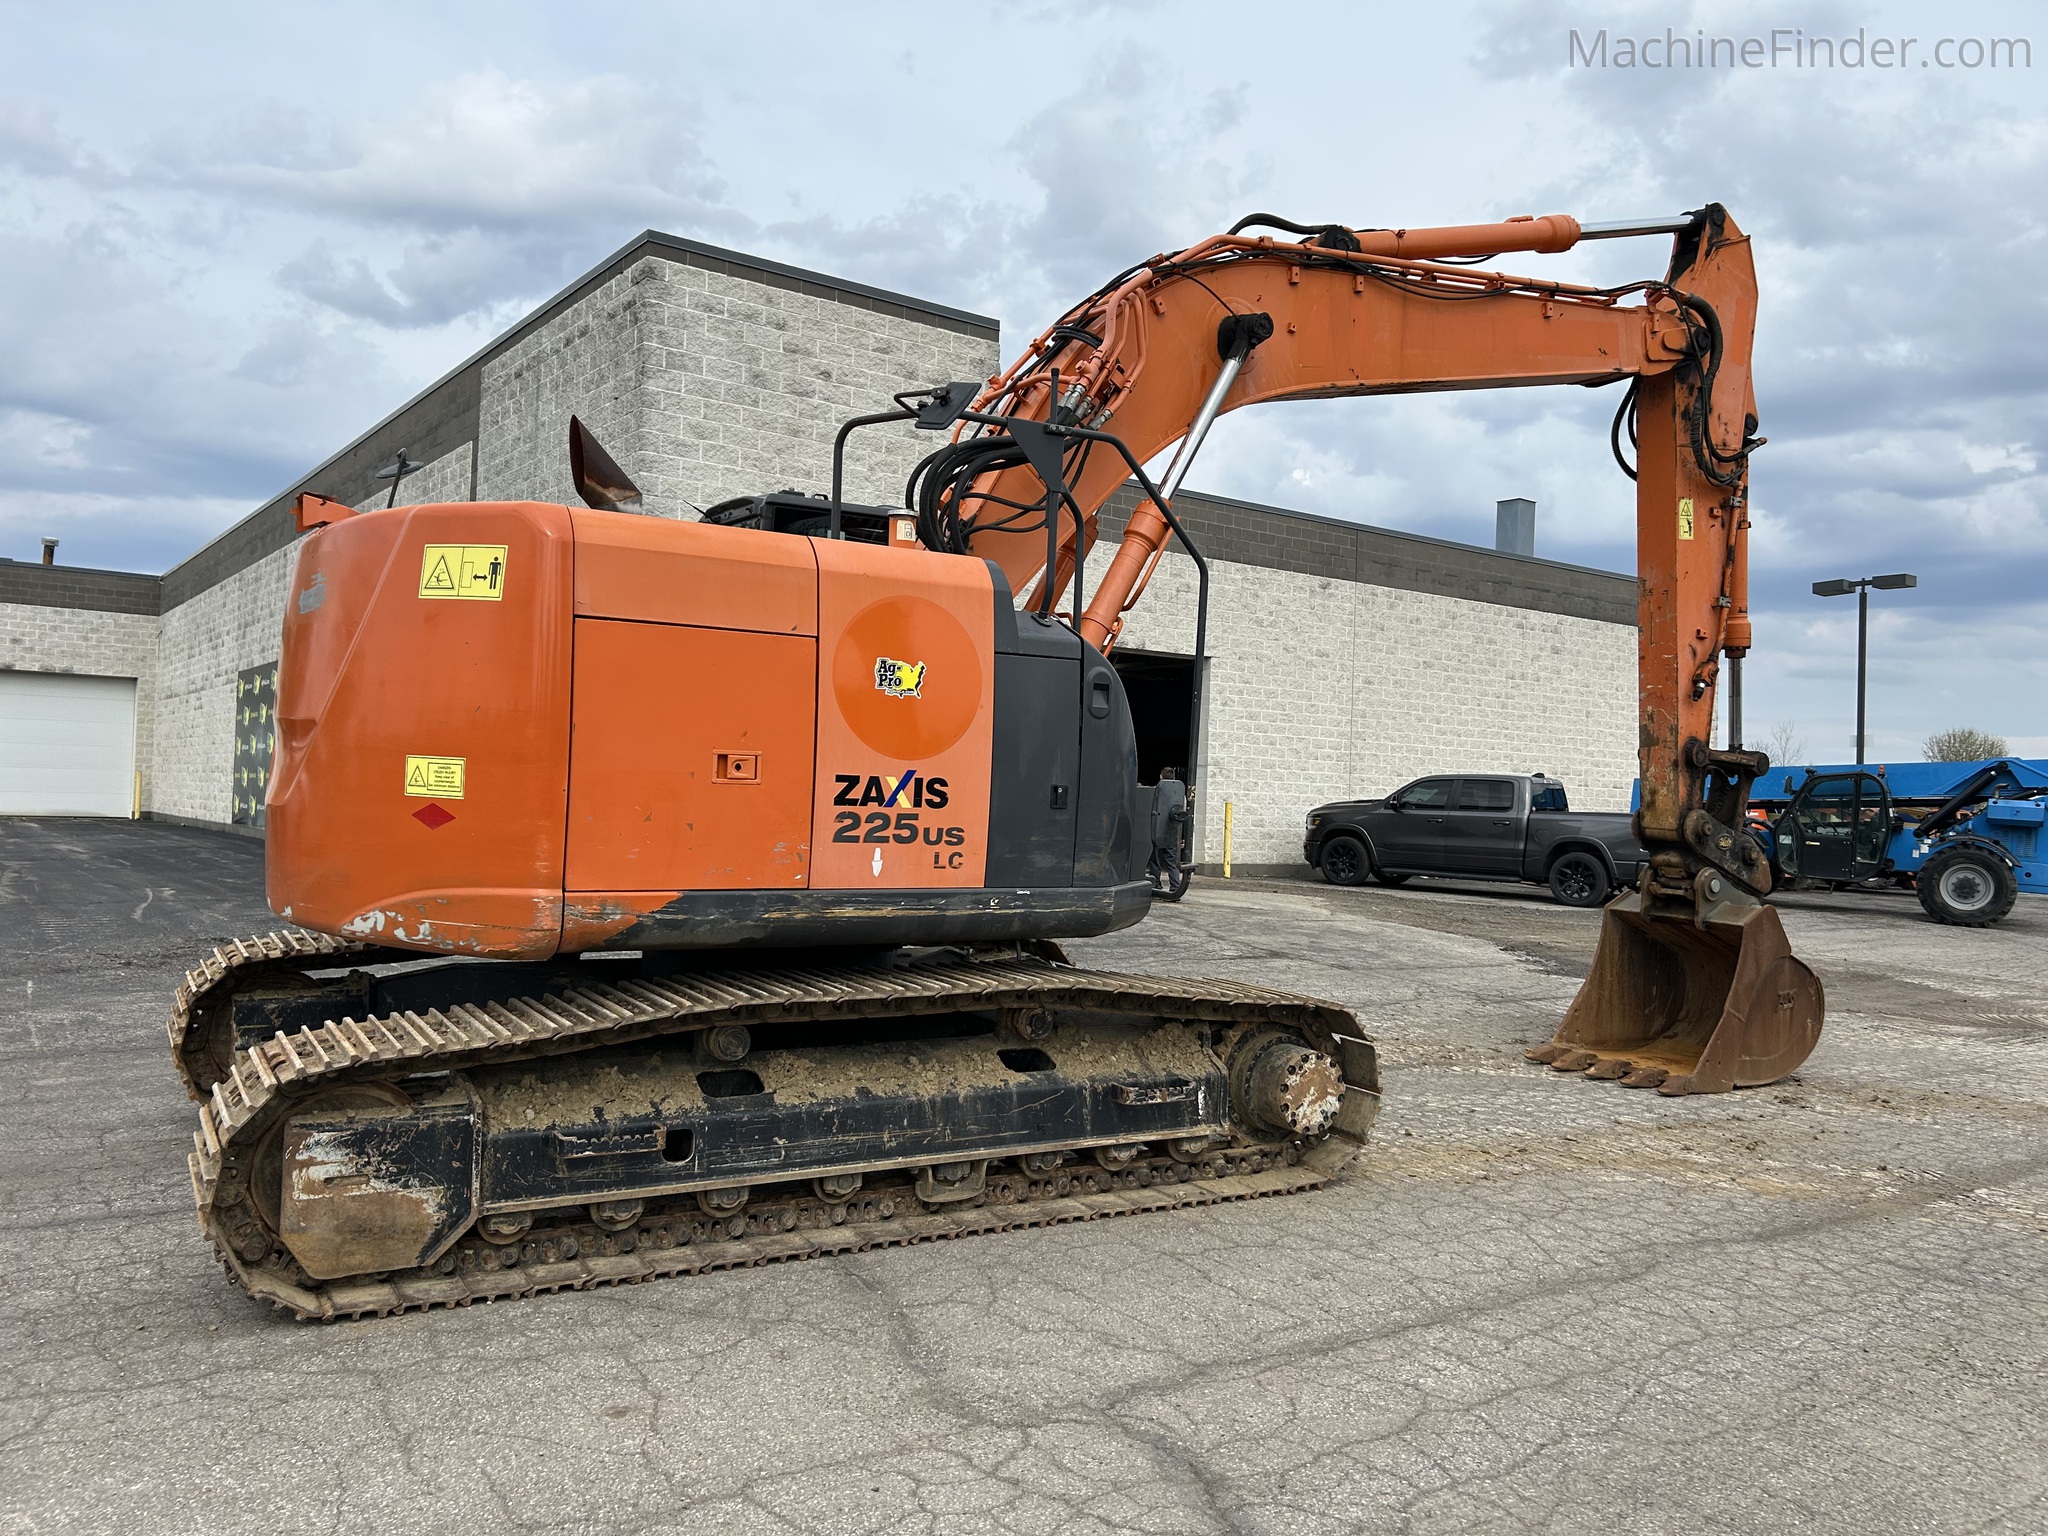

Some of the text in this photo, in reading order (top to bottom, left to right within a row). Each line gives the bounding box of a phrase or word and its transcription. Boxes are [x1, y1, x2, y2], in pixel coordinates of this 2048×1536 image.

[878, 660, 901, 676] Ag-
[878, 674, 902, 687] Pro
[833, 769, 949, 809] ZAXIS
[933, 852, 964, 869] LC
